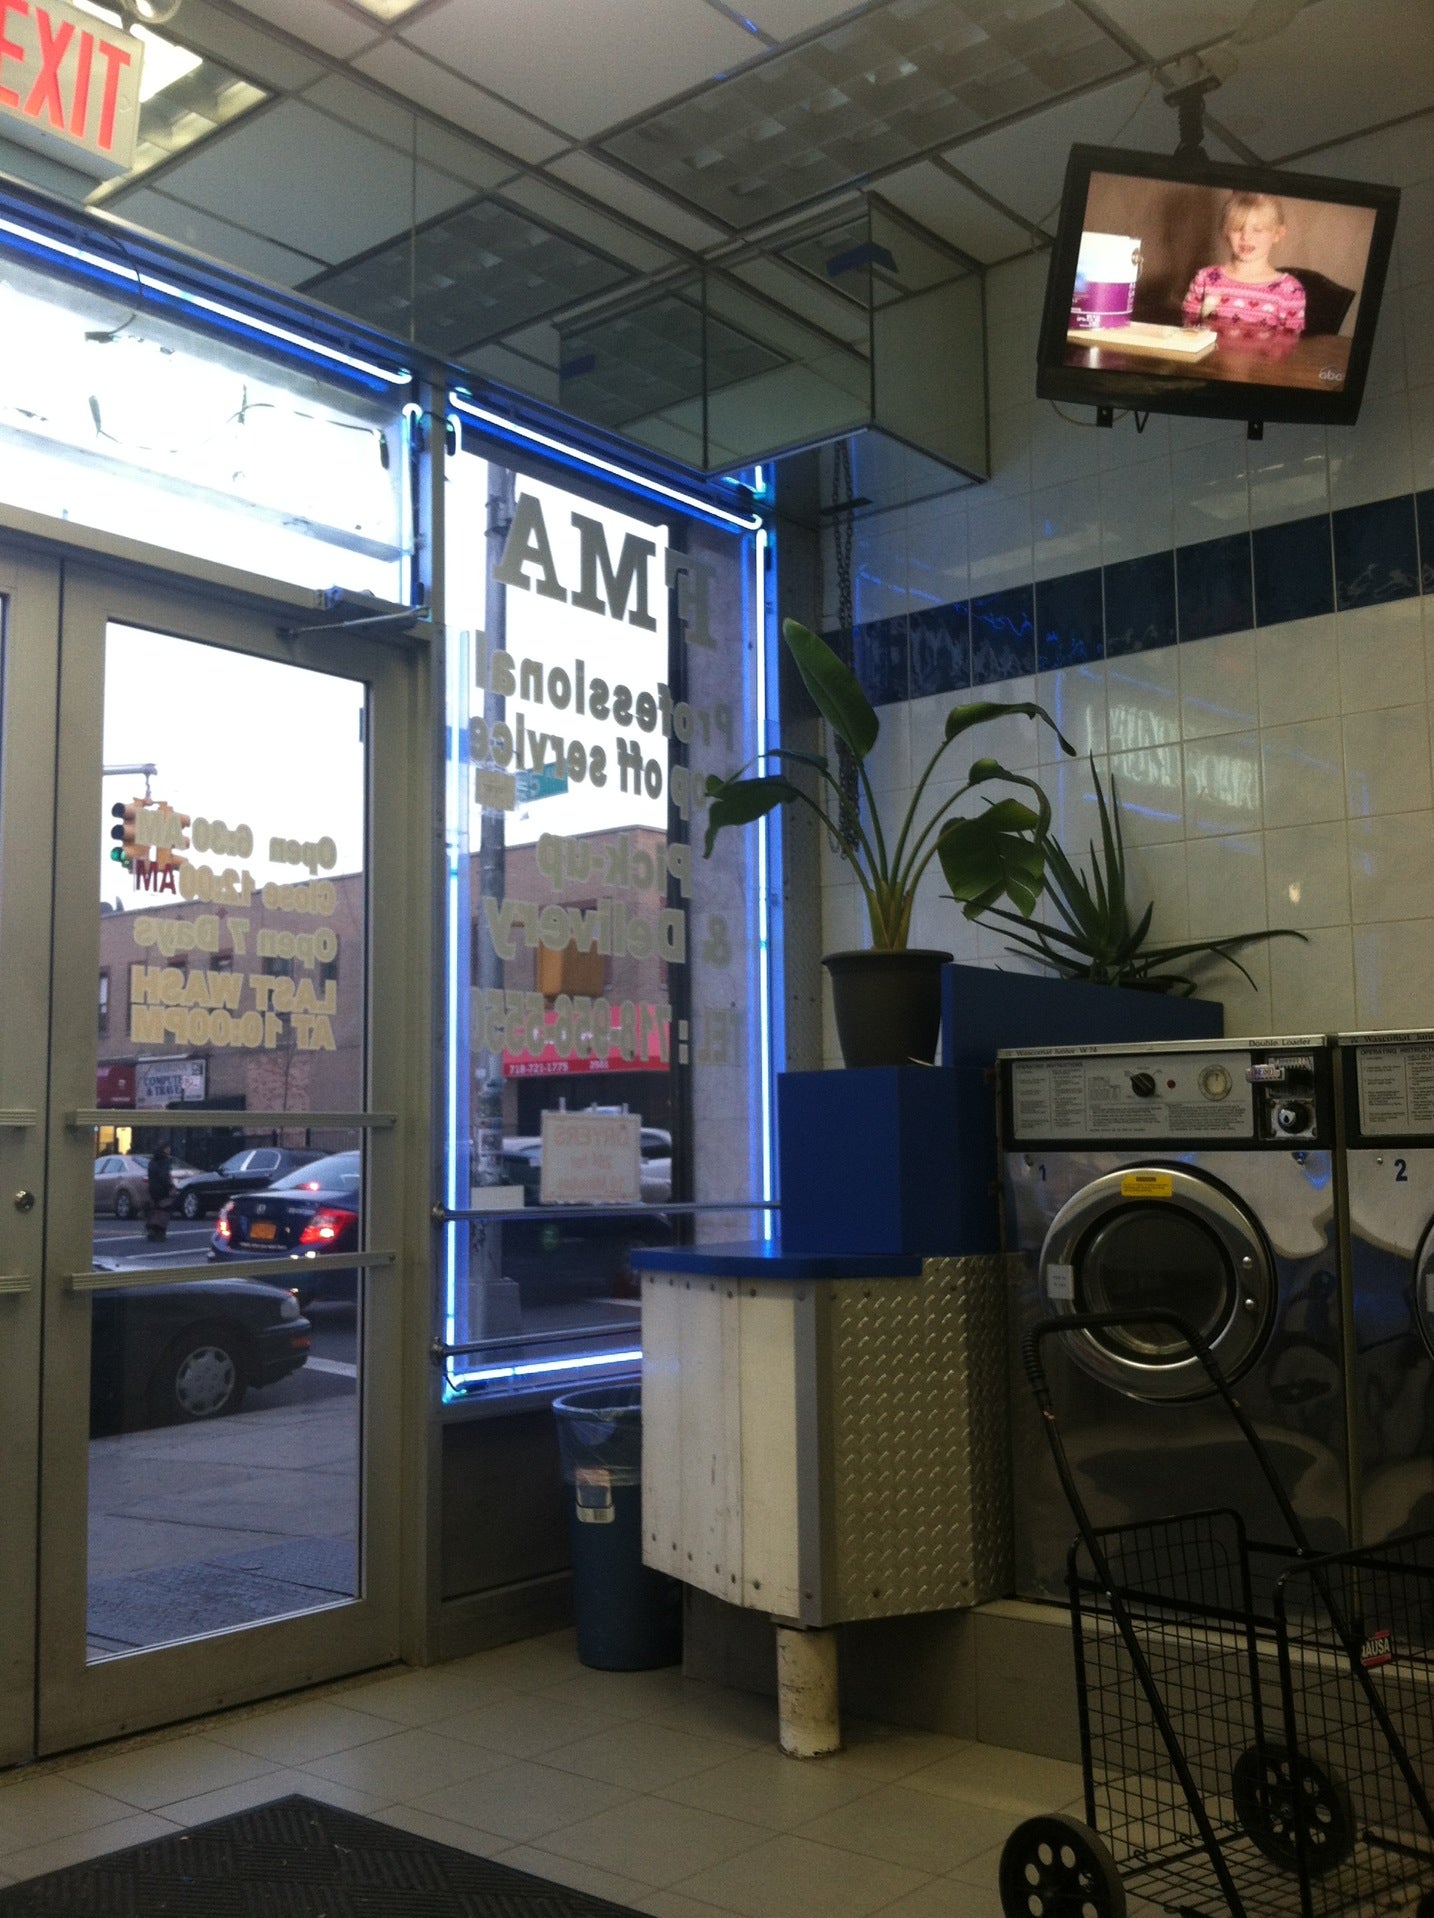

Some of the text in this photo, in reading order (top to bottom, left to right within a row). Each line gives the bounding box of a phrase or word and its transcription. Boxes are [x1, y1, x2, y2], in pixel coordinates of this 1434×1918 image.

[0, 0, 131, 151] EXIT
[1319, 370, 1342, 381] abc
[1249, 1037, 1311, 1047] Double Loader
[144, 1074, 183, 1088] COMPUTE
[155, 1085, 182, 1097] TRAVE
[1038, 1164, 1047, 1181] 1
[1394, 1158, 1408, 1182] 2
